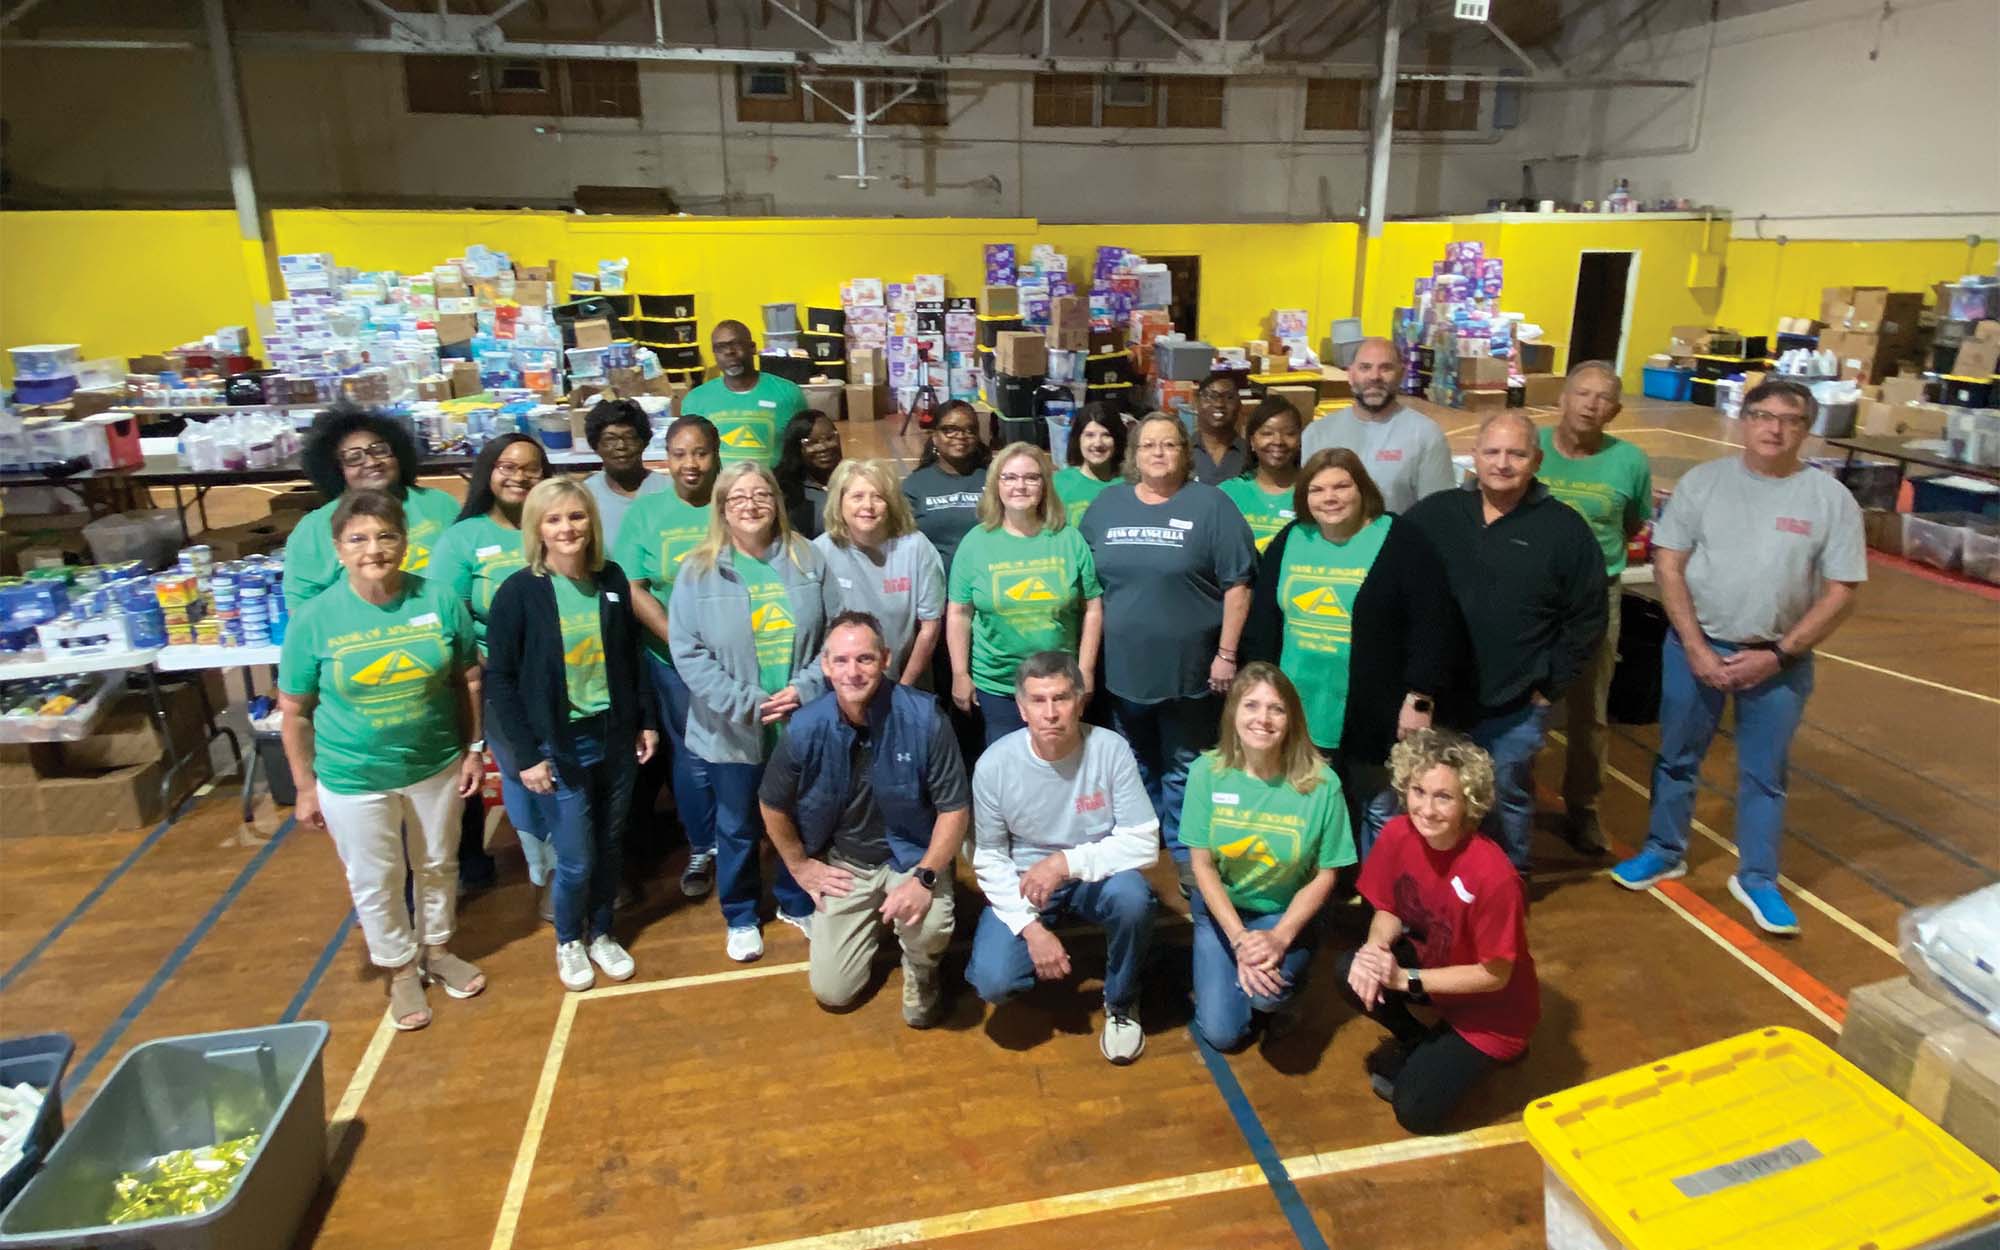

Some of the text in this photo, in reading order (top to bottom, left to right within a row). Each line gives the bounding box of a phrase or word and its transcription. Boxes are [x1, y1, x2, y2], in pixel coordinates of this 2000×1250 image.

[1106, 528, 1127, 540] BANK
[1127, 528, 1139, 539] OF
[1140, 528, 1184, 541] ANGUILLA
